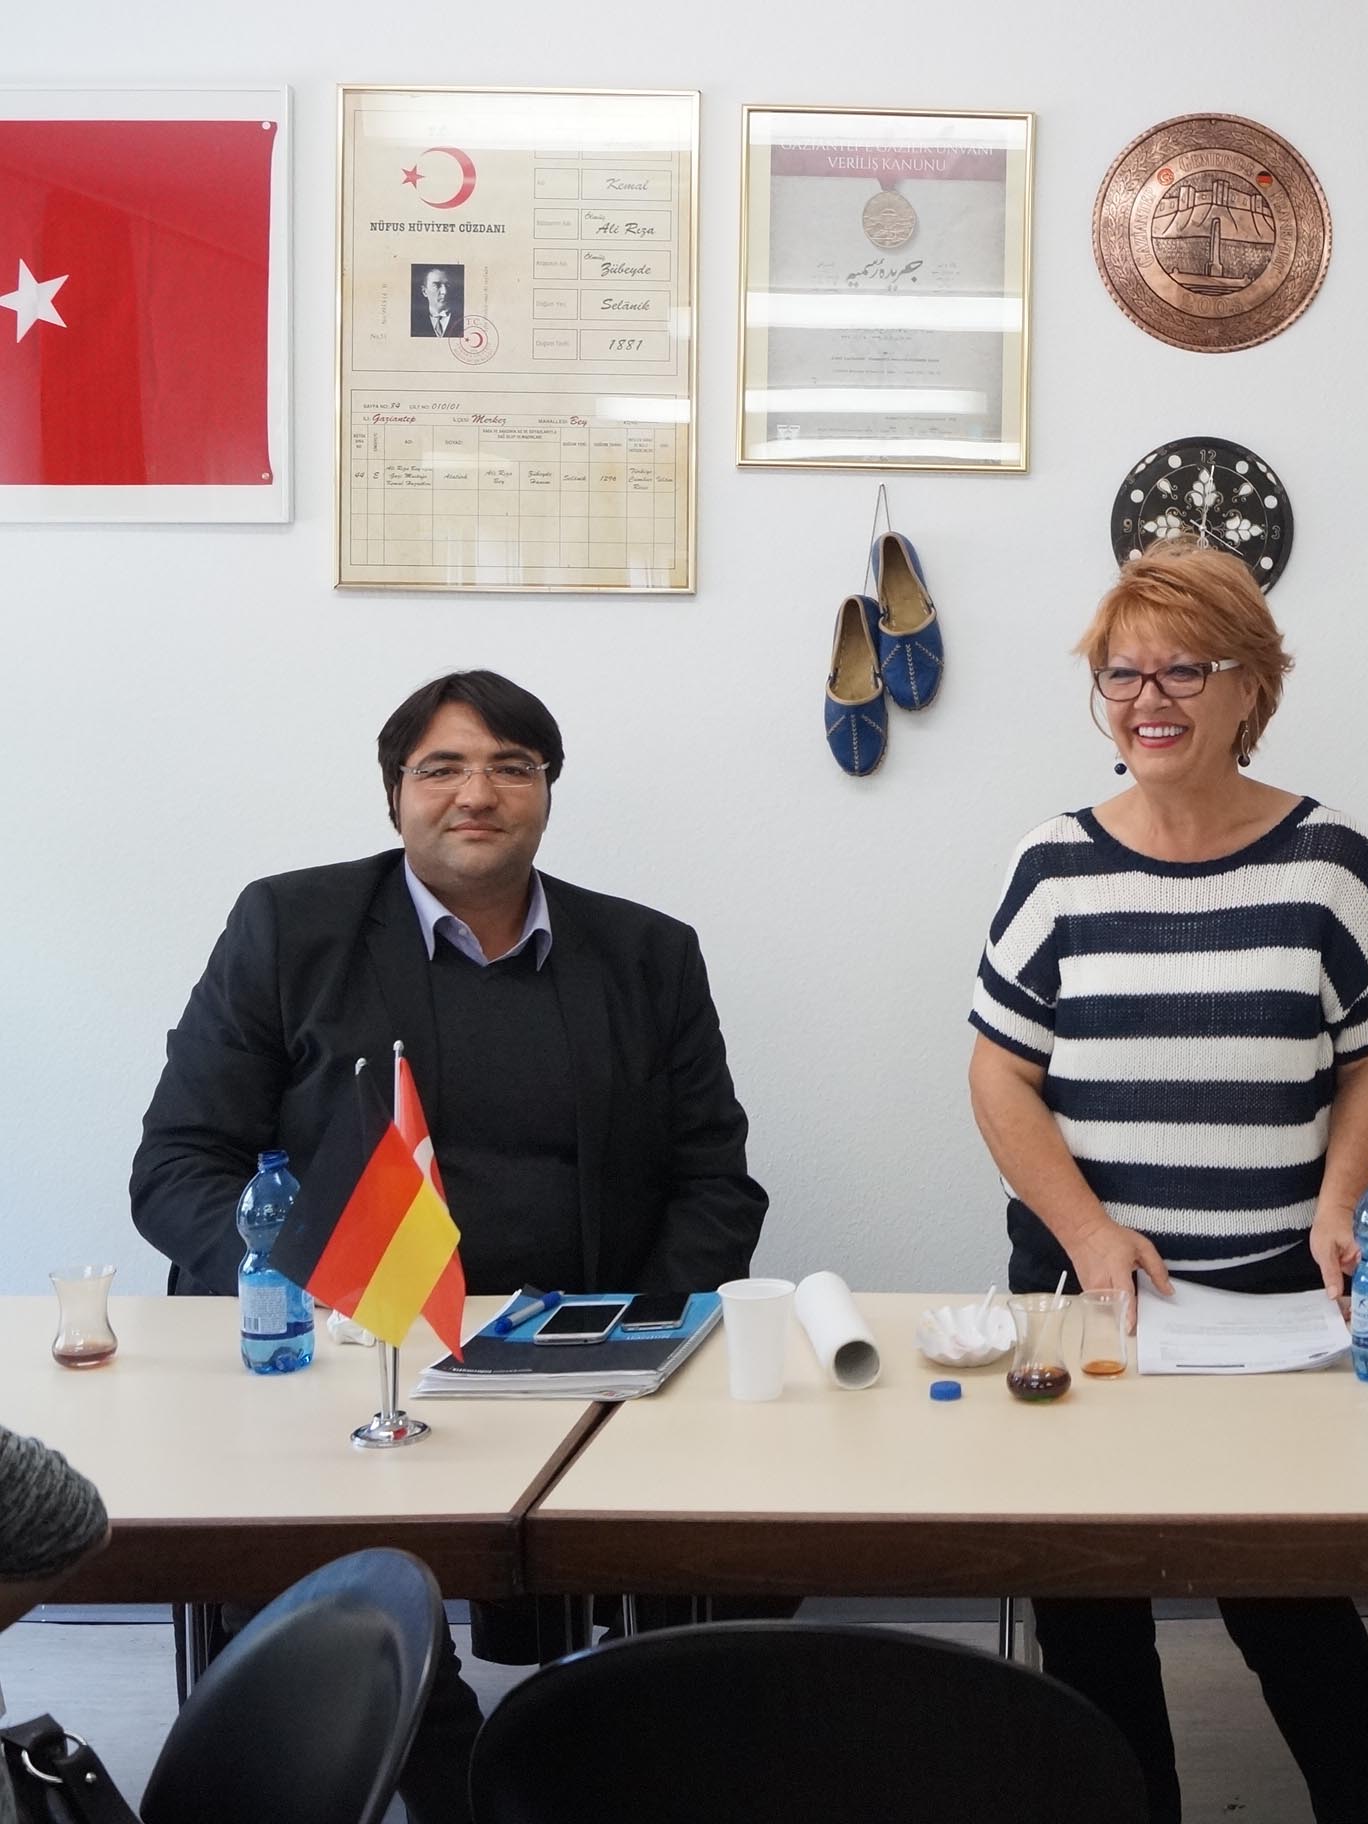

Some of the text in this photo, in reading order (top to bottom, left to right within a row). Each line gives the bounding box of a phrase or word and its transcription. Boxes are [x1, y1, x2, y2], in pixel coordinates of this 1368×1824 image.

[882, 158, 946, 171] KANUNU
[605, 178, 650, 192] Kemal
[369, 219, 506, 234] NÜFUS HÜVİYET CÜZDANI
[595, 222, 655, 238] Ali Rıza
[600, 262, 652, 277] Zübeyde
[608, 338, 644, 351] 1881
[371, 413, 417, 424] Gaziantep
[471, 413, 507, 426] Merkez
[569, 415, 588, 427] Bey
[1199, 448, 1217, 465] 12
[1122, 518, 1133, 533] 9
[1271, 525, 1281, 540] 3
